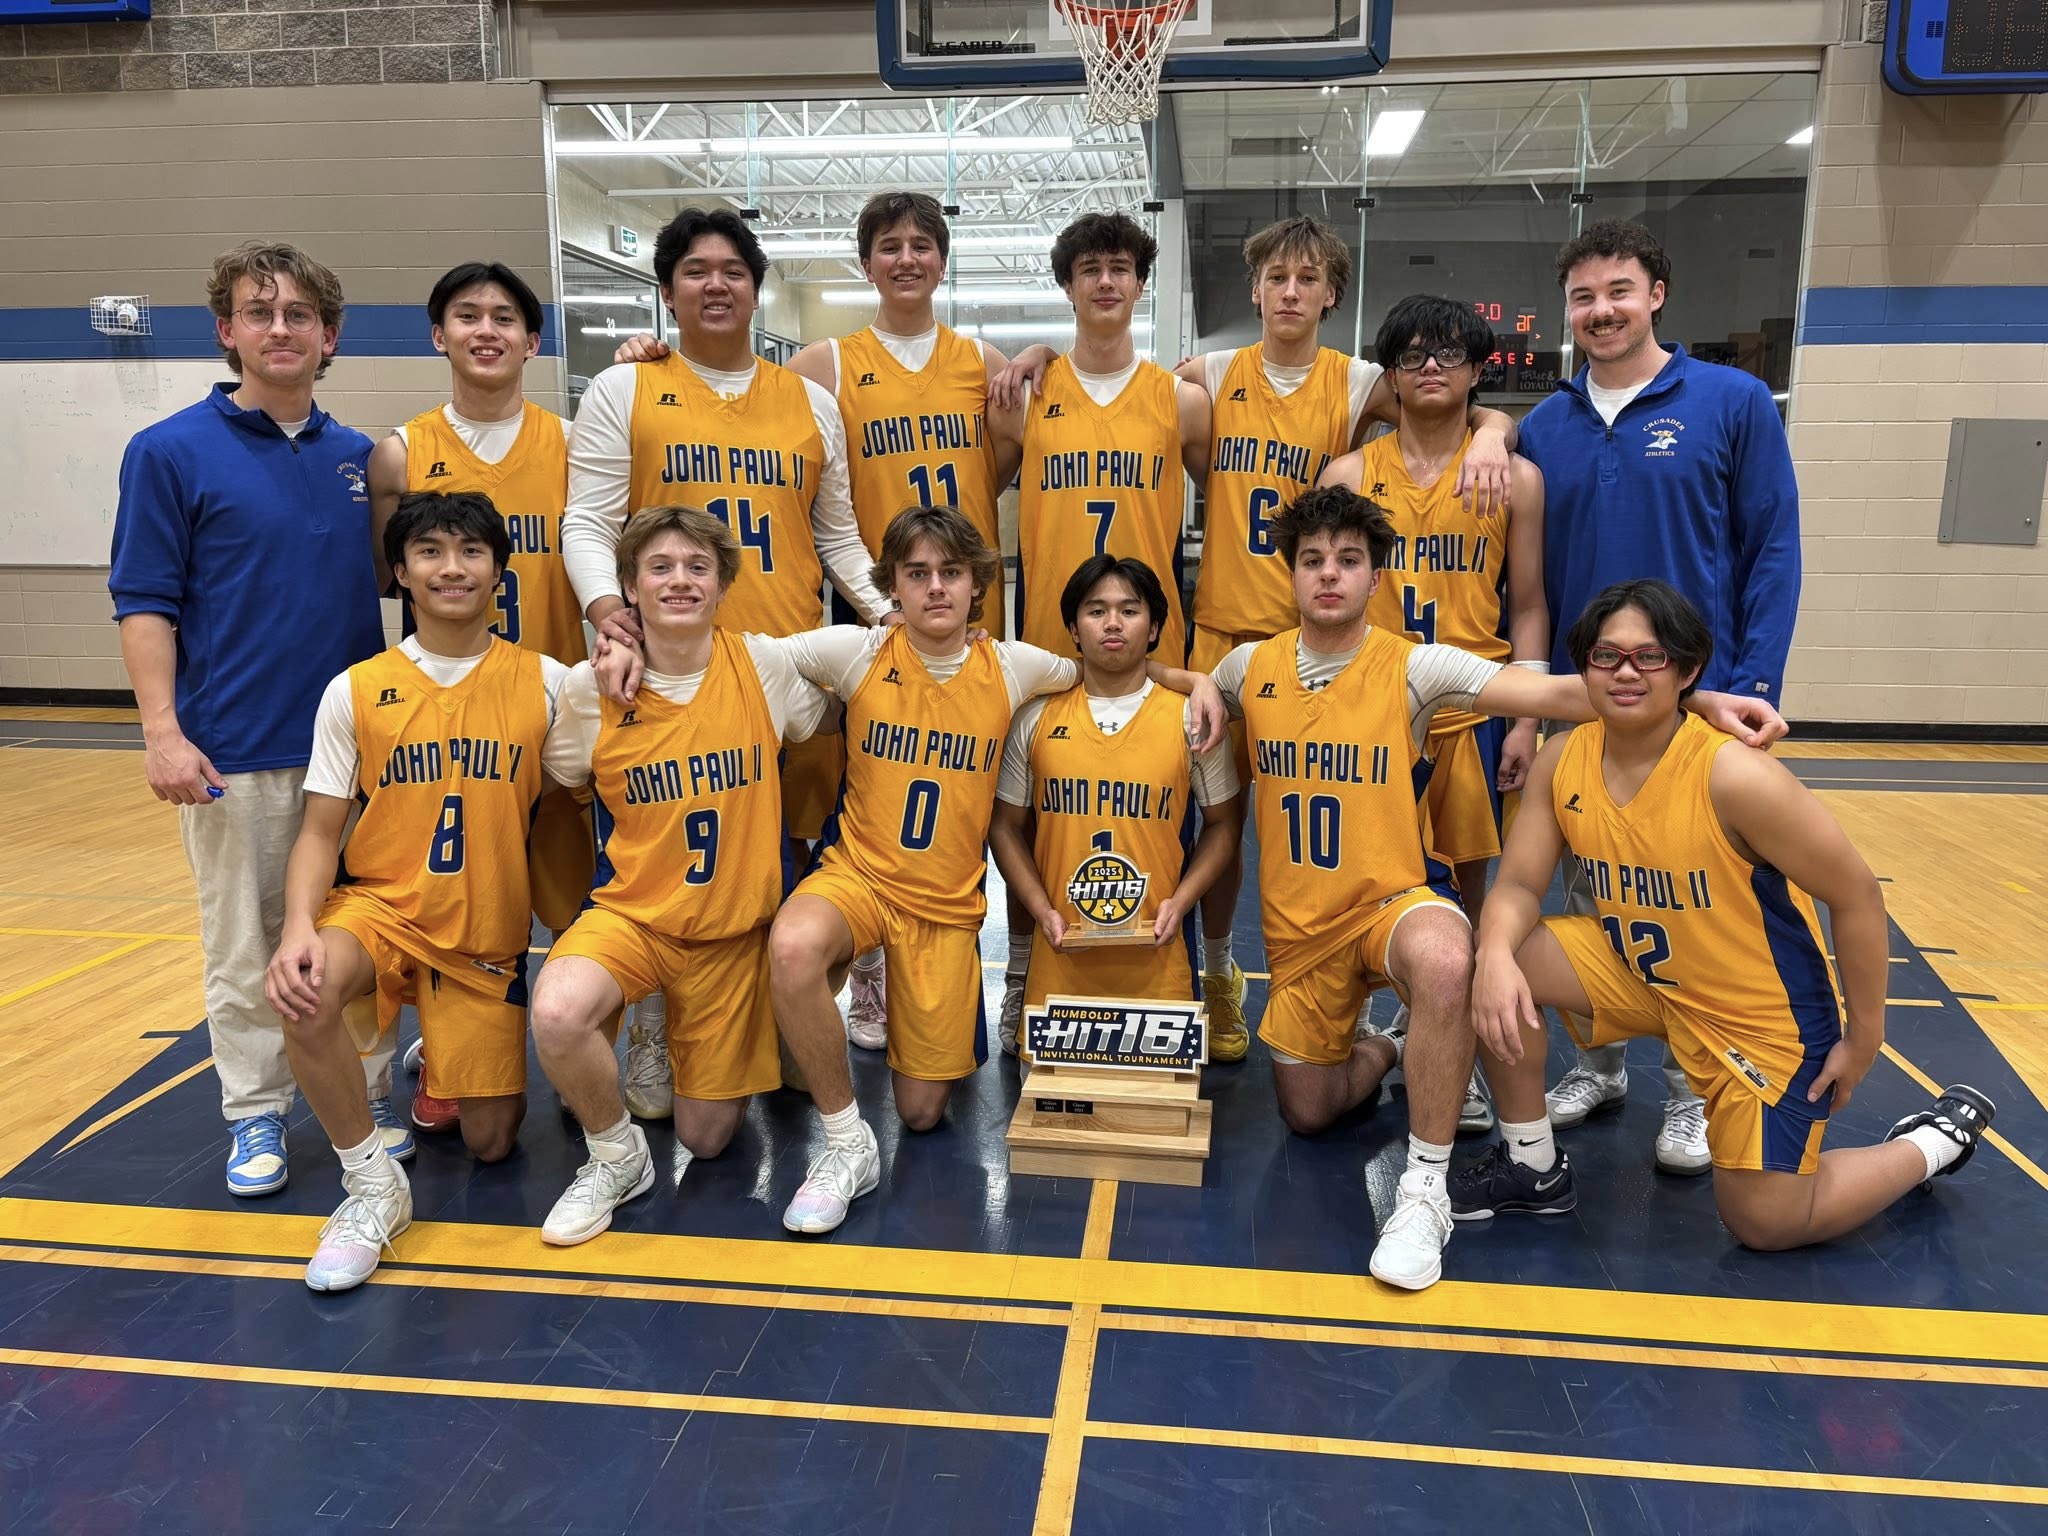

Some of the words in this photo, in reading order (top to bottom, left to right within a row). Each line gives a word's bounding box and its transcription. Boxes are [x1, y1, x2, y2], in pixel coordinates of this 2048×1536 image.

[861, 415, 916, 459] JOHN
[918, 412, 972, 452] PAUL
[1642, 418, 1686, 431] CRUSADER
[661, 443, 722, 484] JOHN
[727, 445, 788, 488] PAUL
[906, 461, 960, 509] 11
[1040, 450, 1089, 492] JOHN
[1095, 448, 1146, 491] PAUL
[1212, 435, 1260, 474] JOHN
[1262, 439, 1313, 485] PAUL
[504, 513, 552, 555] AUL
[1084, 499, 1118, 557] 7
[1247, 486, 1281, 557] 6
[1413, 532, 1469, 574] PAUL
[488, 567, 523, 646] 3
[1402, 582, 1438, 646] 4
[378, 737, 443, 790] JOHN
[448, 735, 503, 783] PAUL
[861, 718, 921, 766] JOHN
[923, 728, 978, 774] PAUL
[1304, 740, 1365, 785] PAUL
[623, 758, 685, 808] JOHN
[686, 747, 750, 798] PAUL
[1040, 776, 1090, 817] JOHN
[1096, 778, 1152, 822] PAUL
[425, 792, 466, 876] 8
[898, 776, 943, 852] 0
[1280, 790, 1343, 871] 10
[683, 806, 722, 887] 9
[1094, 867, 1118, 877] 2025
[1618, 862, 1685, 912] PAUL
[1600, 913, 1681, 988] 12
[1051, 1008, 1120, 1022] HUMBOLDT
[1040, 1050, 1114, 1063] INVITATIONAL
[1117, 1053, 1190, 1067] TOURNAMENT
